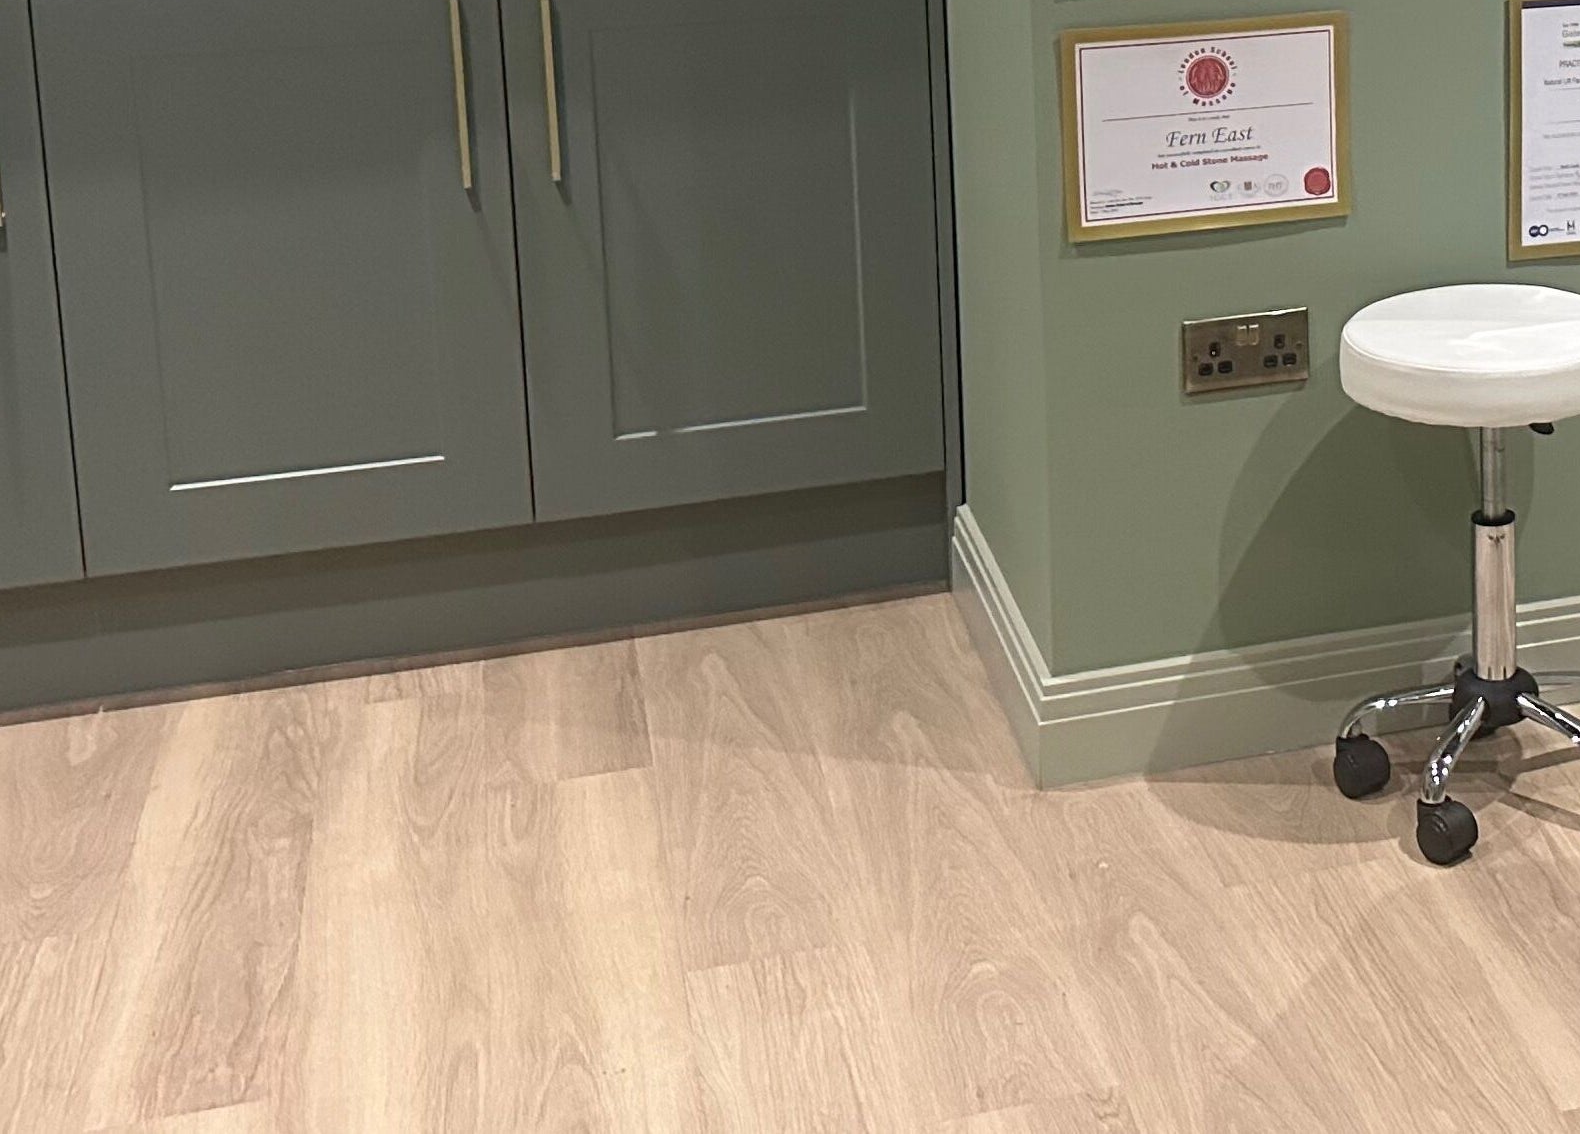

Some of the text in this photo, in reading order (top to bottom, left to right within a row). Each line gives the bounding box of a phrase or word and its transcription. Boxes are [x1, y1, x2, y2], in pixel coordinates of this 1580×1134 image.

[1166, 126, 1253, 147] Fern East
[1152, 162, 1168, 170] Hot
[1180, 160, 1200, 168] Cold
[1202, 158, 1228, 166] Stone
[1231, 154, 1269, 163] Massage
